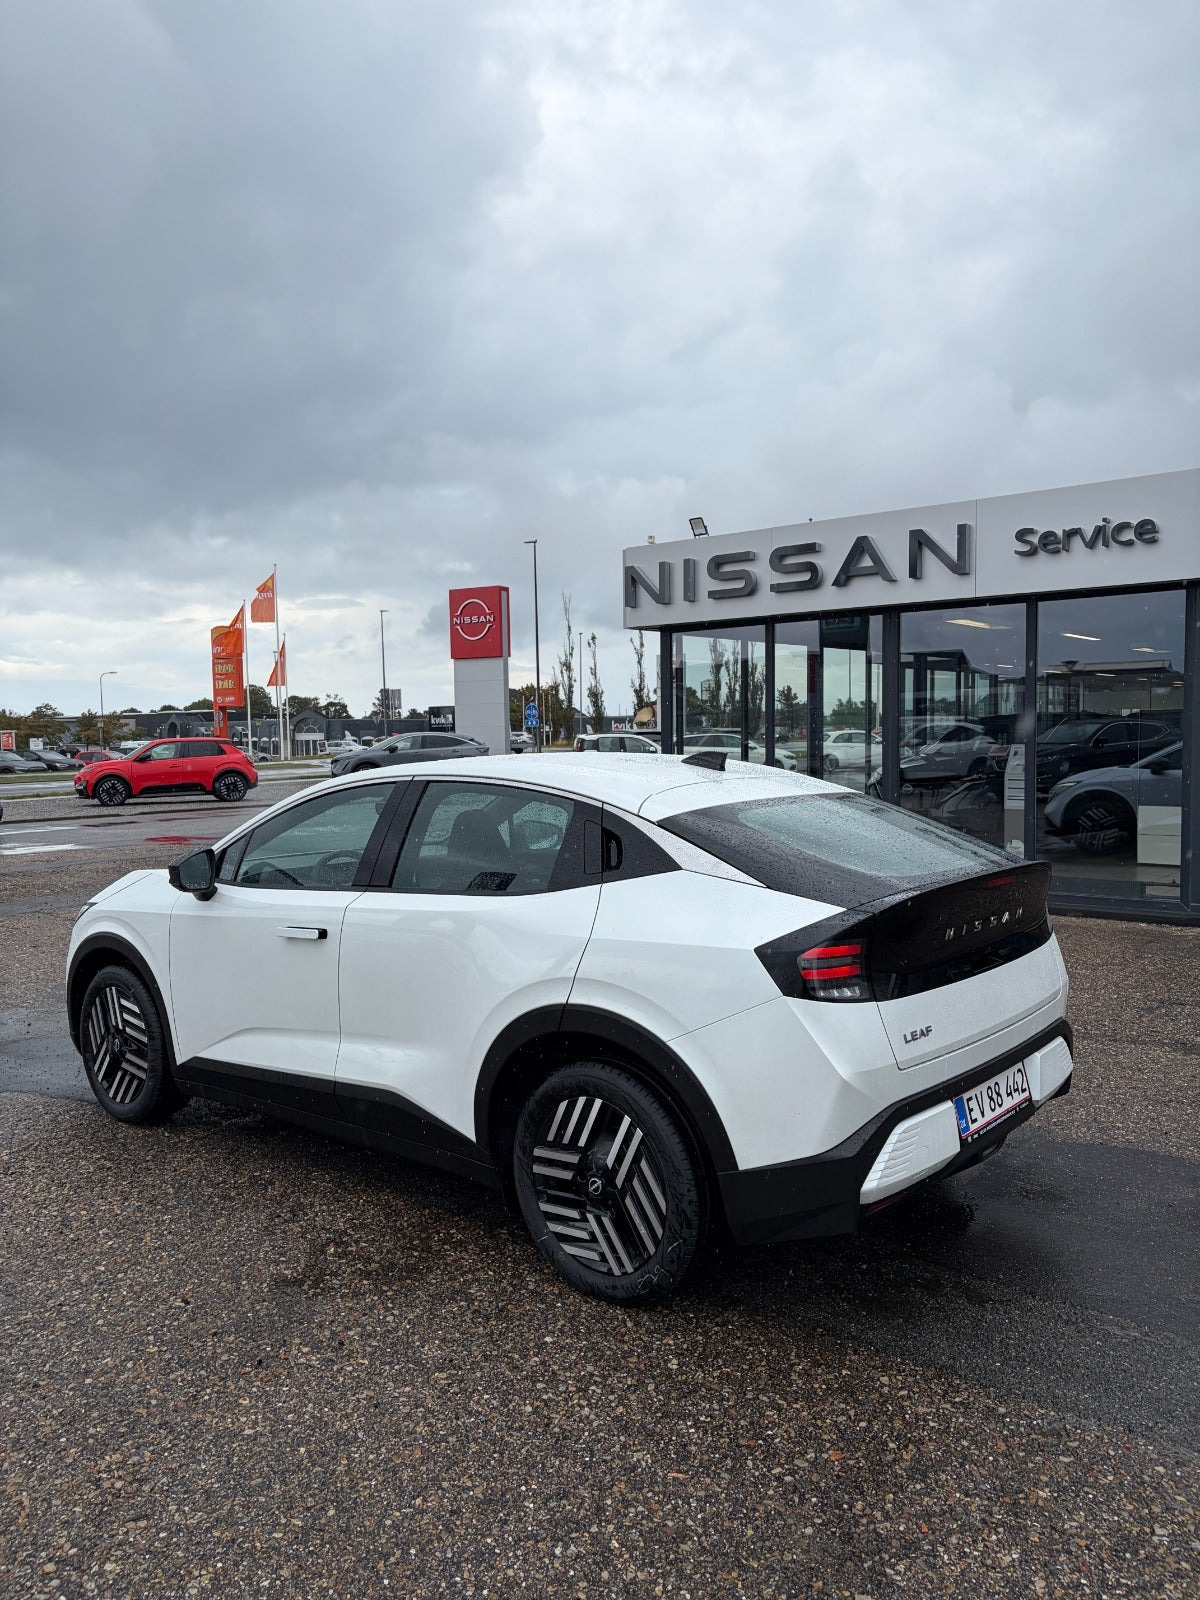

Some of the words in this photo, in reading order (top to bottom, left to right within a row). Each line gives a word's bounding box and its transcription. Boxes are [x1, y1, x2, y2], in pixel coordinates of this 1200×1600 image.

[1014, 517, 1159, 557] Service
[624, 523, 971, 609] NISSAN
[453, 614, 494, 625] NISSAN
[945, 906, 1024, 941] NISSAN
[903, 1025, 933, 1044] LEAF
[966, 1090, 985, 1125] EV
[986, 1081, 1004, 1113] 88
[1005, 1067, 1028, 1101] 442
